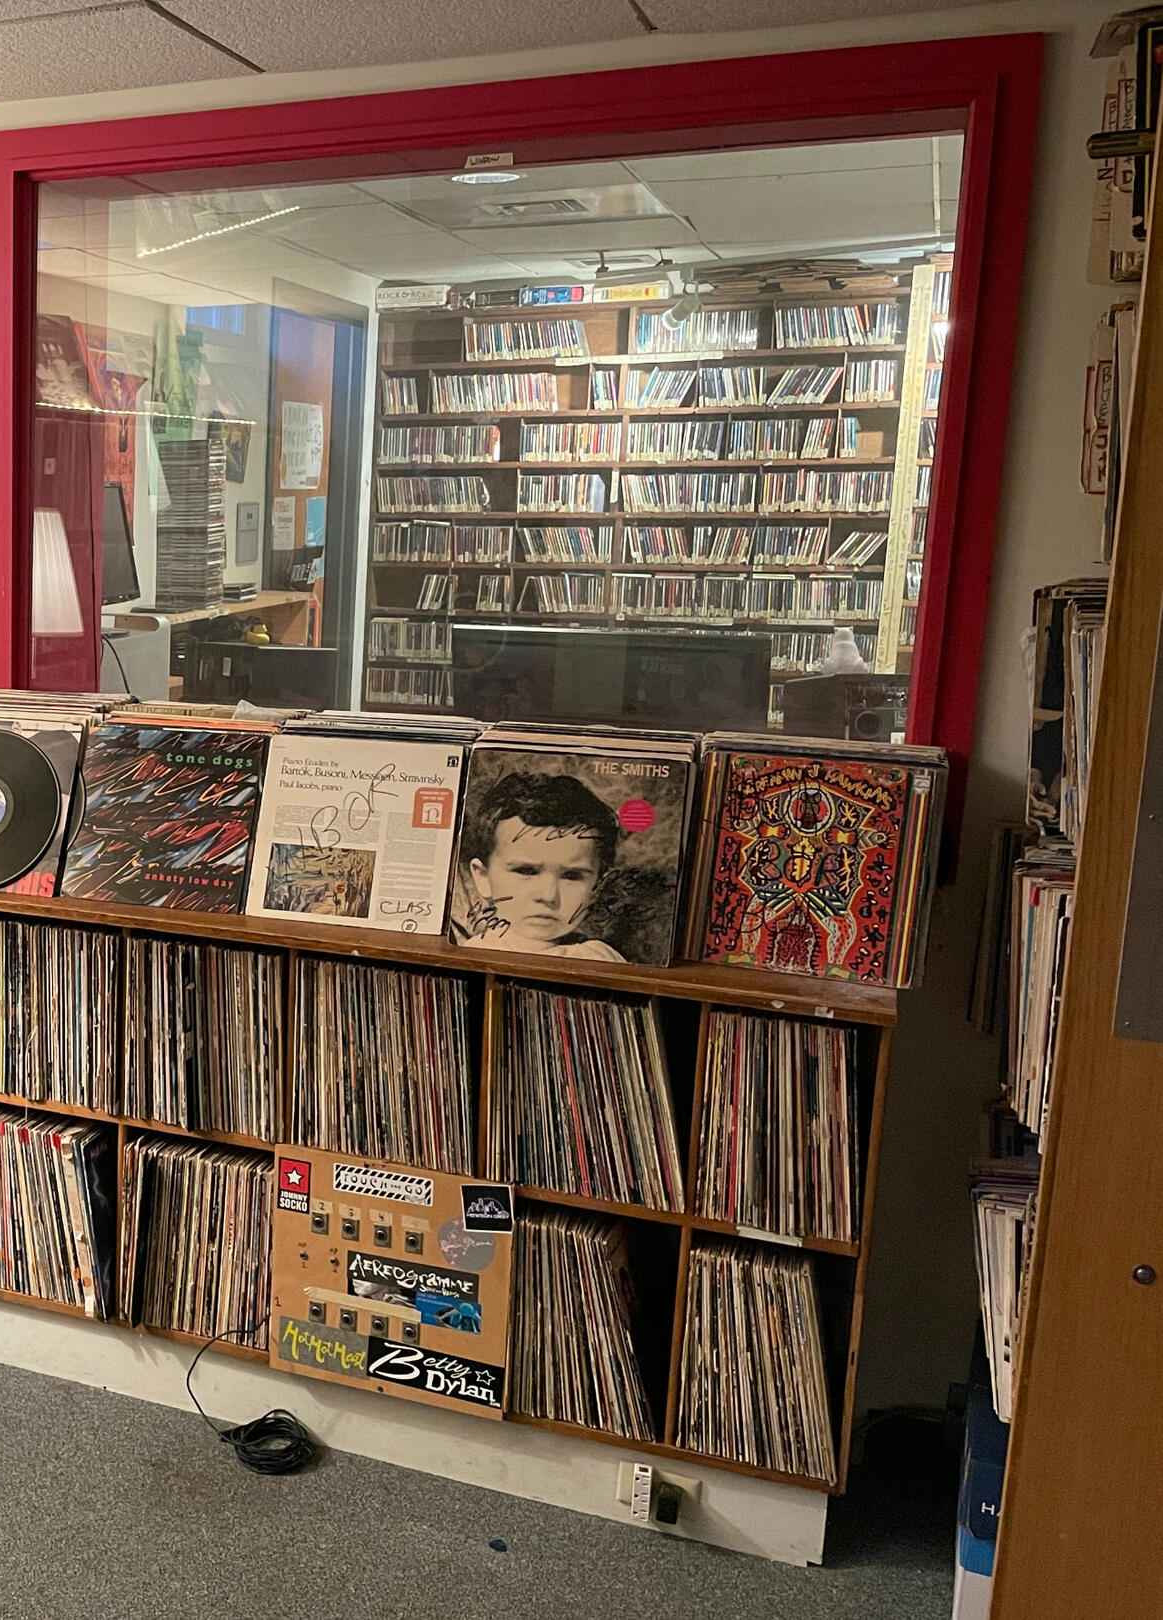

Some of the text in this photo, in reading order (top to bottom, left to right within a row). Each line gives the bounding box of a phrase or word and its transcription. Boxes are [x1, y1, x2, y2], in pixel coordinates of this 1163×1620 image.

[166, 752, 253, 769] tone dogs
[282, 757, 304, 765] Piano
[330, 760, 339, 768] by
[315, 767, 348, 780] Busoni,
[399, 773, 445, 786] Stravinsky
[592, 761, 670, 778] THE SMITHS
[279, 780, 295, 788] Paul
[321, 784, 343, 792] piano
[188, 875, 210, 886] low
[213, 878, 234, 890] day
[379, 901, 433, 916] CLASS
[280, 1190, 308, 1202] JOHNNY
[404, 1184, 423, 1195] GO
[279, 1197, 308, 1212] SOCKO
[368, 1342, 472, 1381] Betty
[425, 1369, 496, 1402] Dylan
